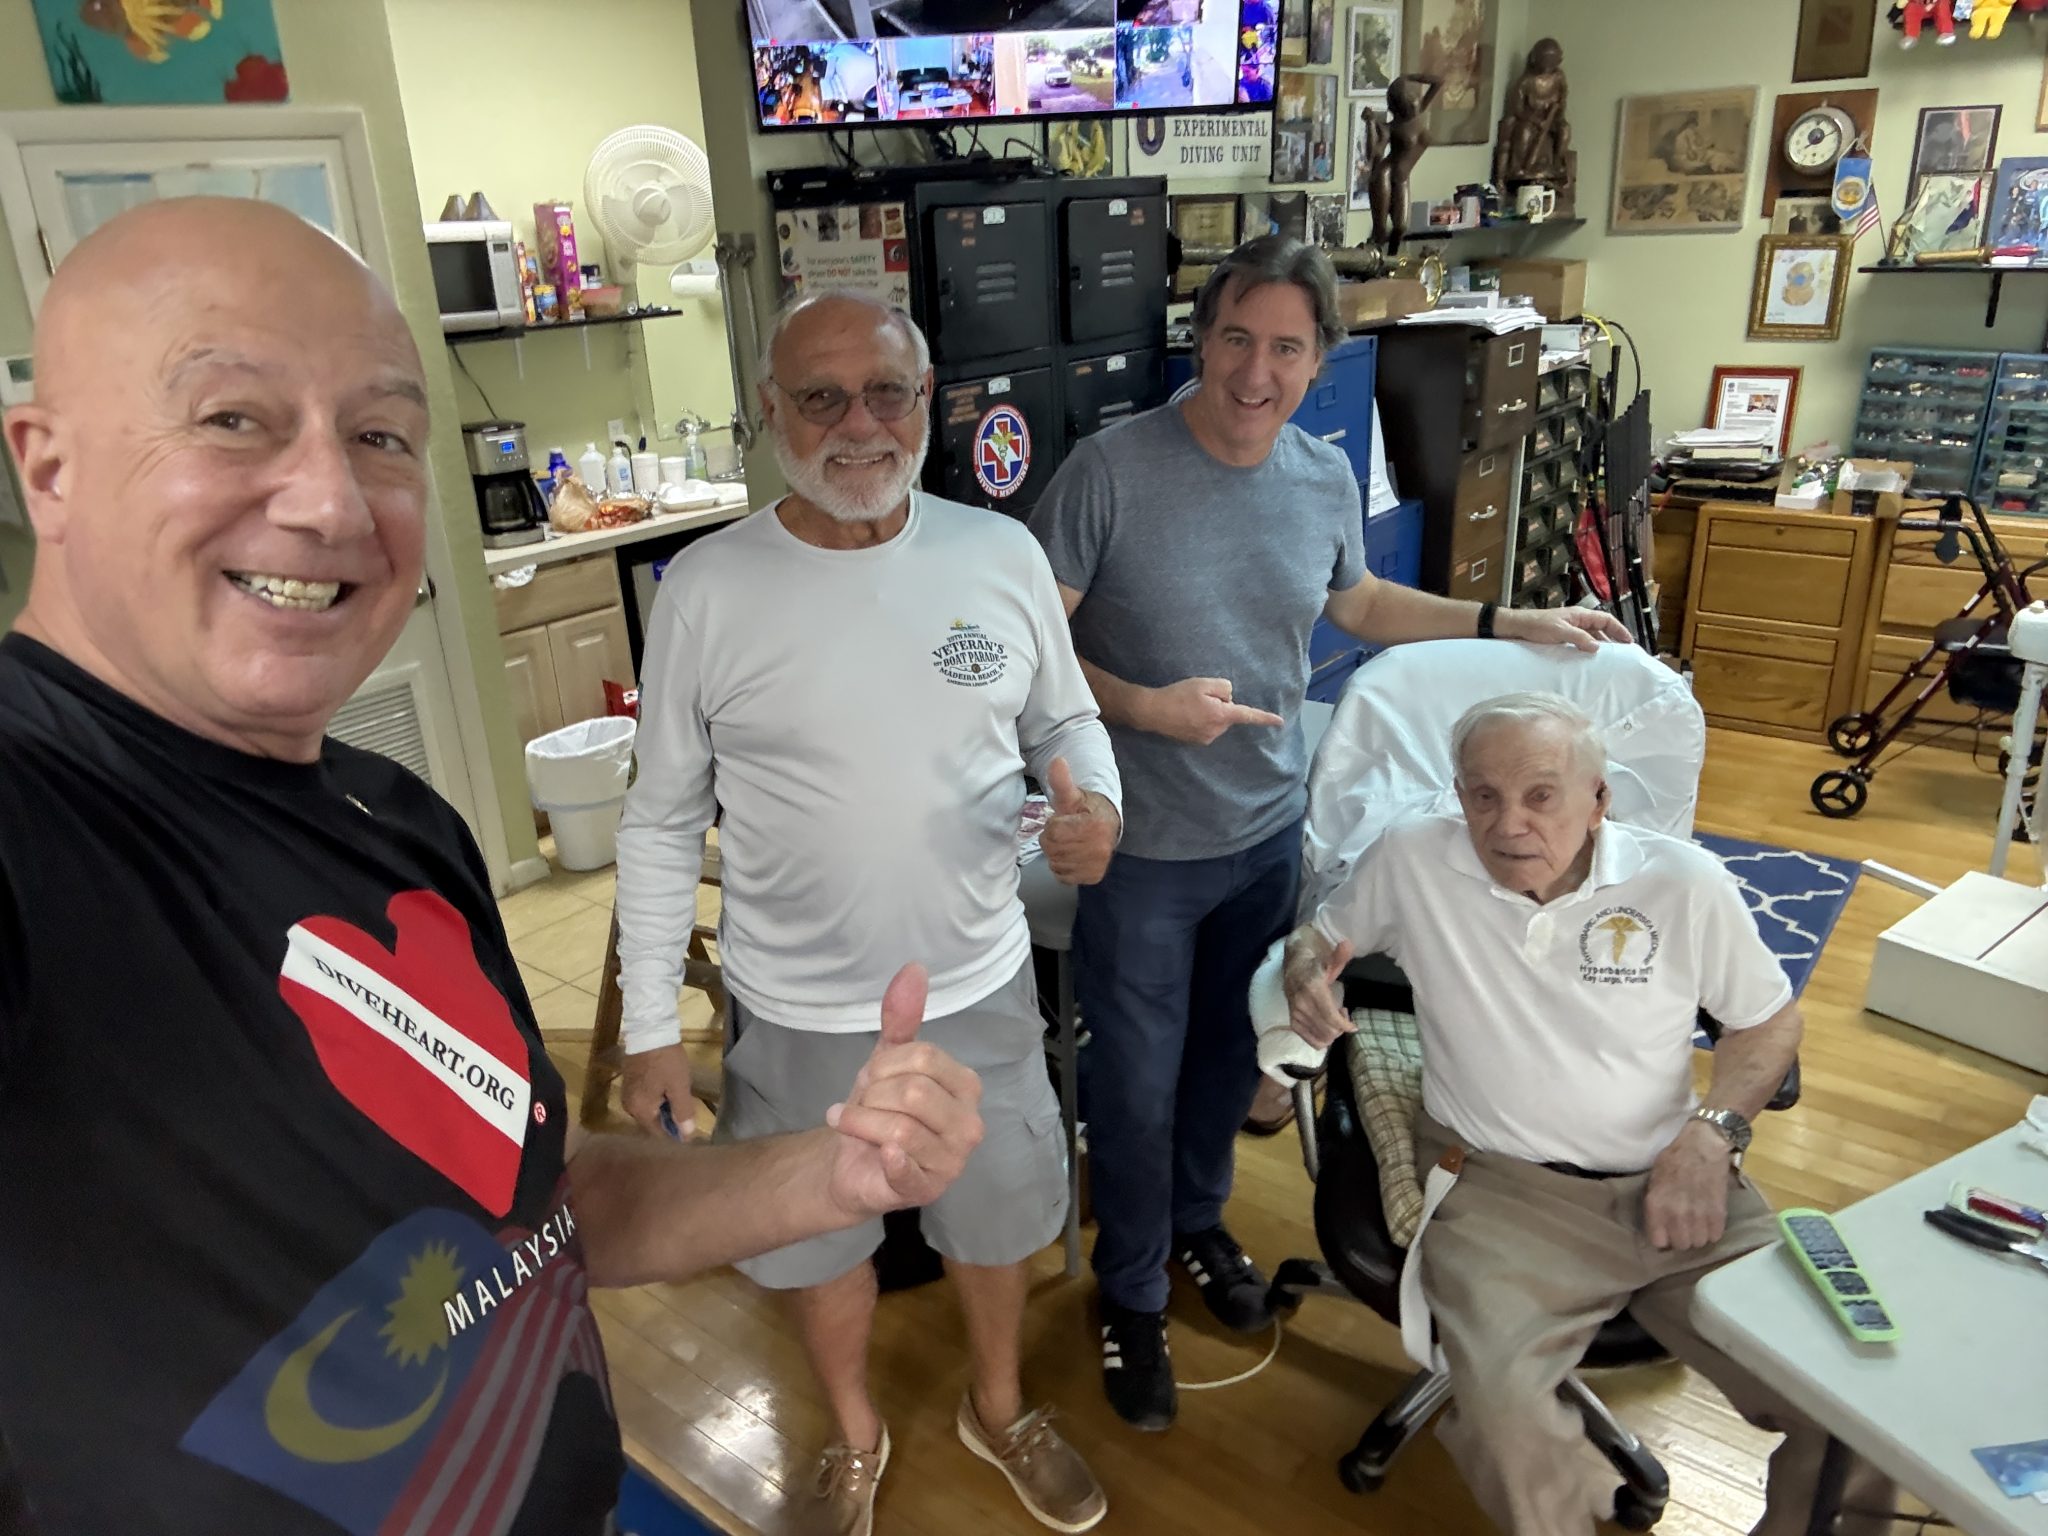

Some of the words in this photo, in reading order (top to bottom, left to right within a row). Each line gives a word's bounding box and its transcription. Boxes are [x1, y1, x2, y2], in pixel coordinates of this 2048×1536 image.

[1173, 119, 1268, 137] EXPERIMENTAL
[1180, 145, 1224, 164] DIVING
[1231, 145, 1262, 163] UNIT
[850, 255, 877, 264] SAFETY
[976, 471, 998, 497] DIVING
[999, 463, 1029, 498] MEDICINE
[964, 632, 988, 640] ANNUAL
[932, 640, 1004, 659] VETERAN'S
[943, 652, 966, 667] BOAT
[968, 651, 1000, 663] PARADE
[939, 668, 977, 680] MADEIRA
[1596, 907, 1612, 919] AND
[1614, 906, 1654, 930] UNDERSEA
[1580, 965, 1636, 975] Hyperbarics
[1582, 975, 1597, 984] Key
[1599, 976, 1623, 984] Largo,
[311, 953, 516, 1113] DIVEHEART.ORG
[442, 1203, 576, 1337] MALAYSIA
